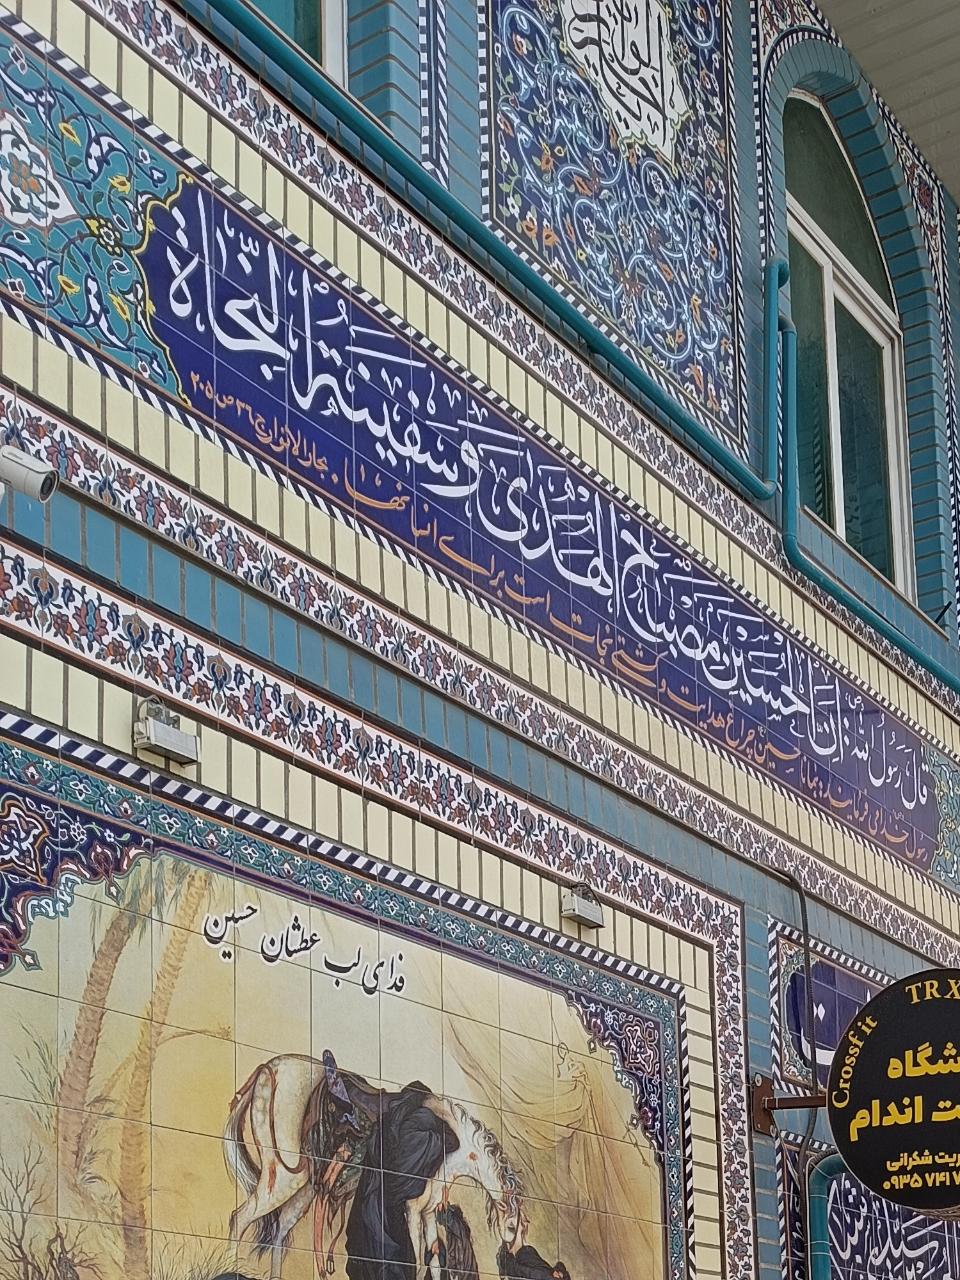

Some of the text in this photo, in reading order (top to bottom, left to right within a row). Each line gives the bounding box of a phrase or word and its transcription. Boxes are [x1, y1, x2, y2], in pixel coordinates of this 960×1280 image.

[203, 904, 259, 960] حسین
[324, 946, 363, 988] لب
[849, 1096, 924, 1142] اندام
[886, 1149, 933, 1172] شکرانی
